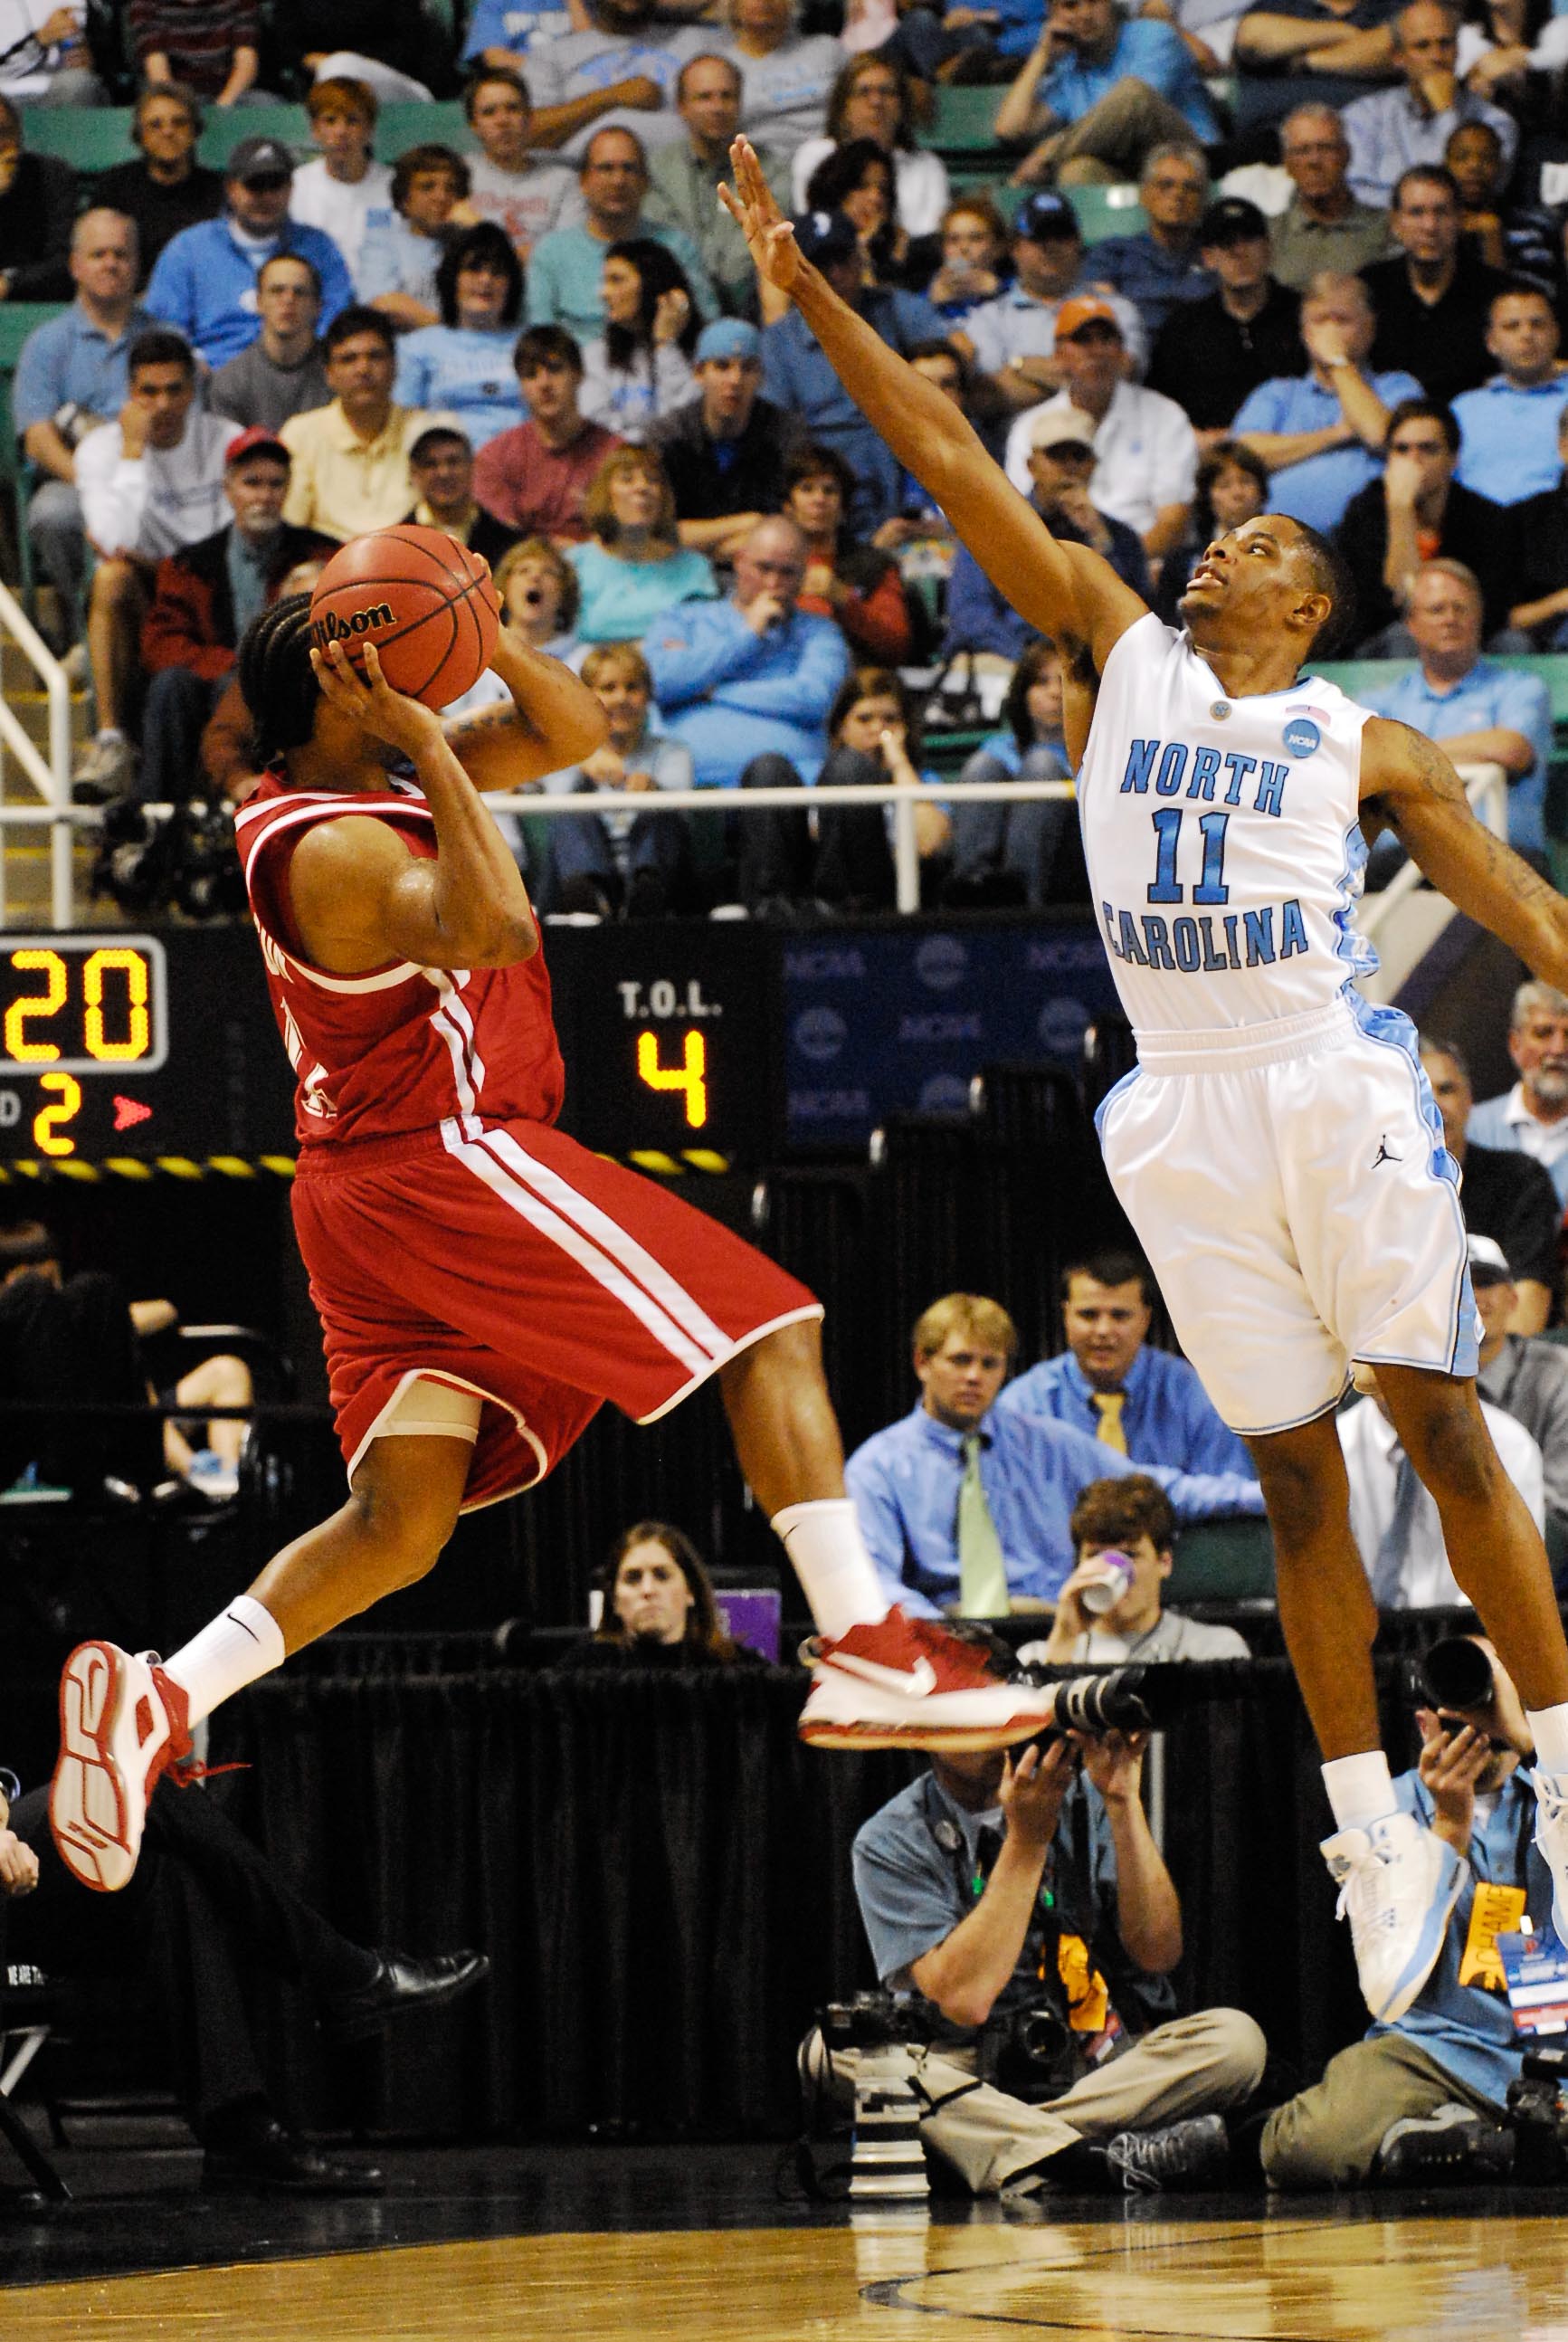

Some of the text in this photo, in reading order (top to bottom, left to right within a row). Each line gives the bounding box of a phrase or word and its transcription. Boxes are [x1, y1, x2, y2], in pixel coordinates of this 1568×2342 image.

[1120, 739, 1290, 818] NORTH
[1288, 734, 1317, 749] NCAA
[1147, 807, 1231, 905] 11
[1102, 899, 1309, 973] CAROLINA
[5, 949, 148, 1062] 20
[617, 980, 723, 1018] T.O.L.
[34, 1072, 81, 1156] 2
[638, 1030, 707, 1128] 4
